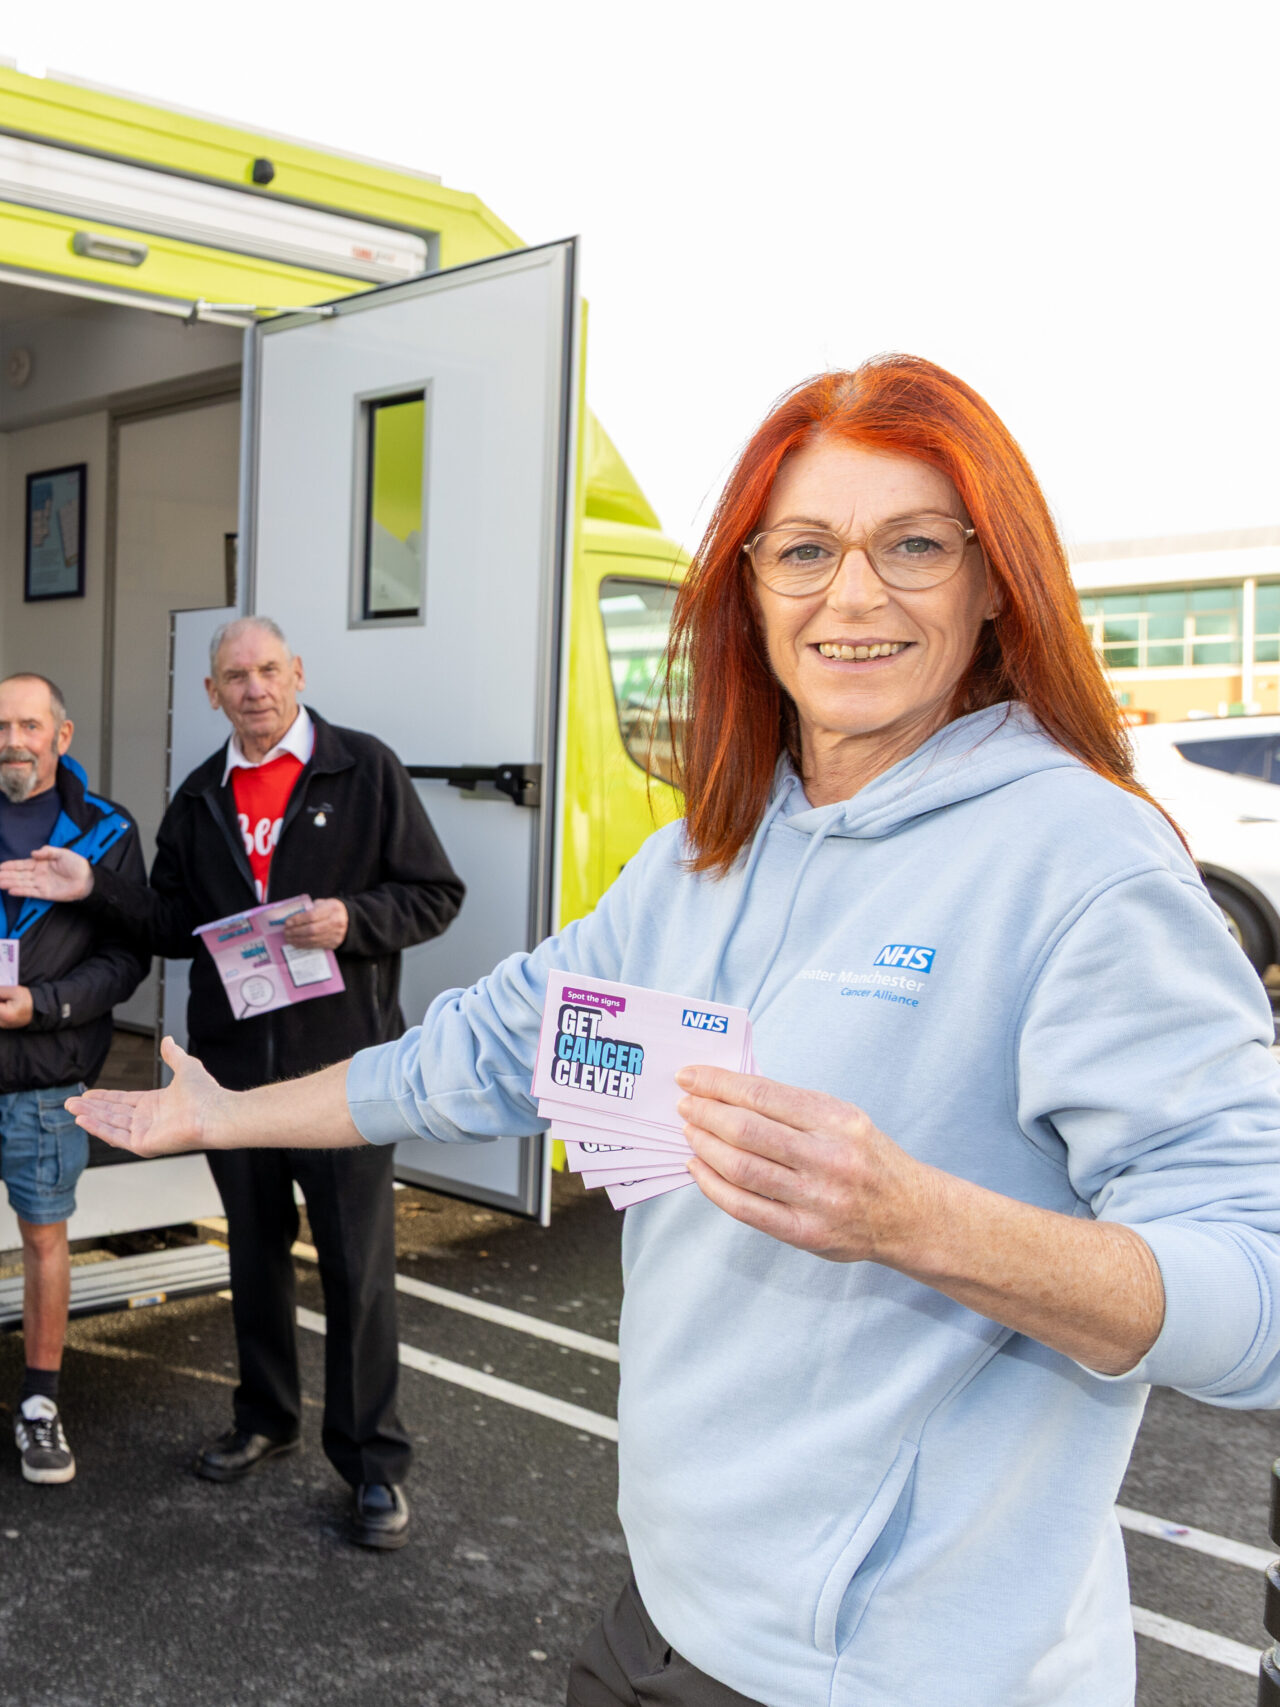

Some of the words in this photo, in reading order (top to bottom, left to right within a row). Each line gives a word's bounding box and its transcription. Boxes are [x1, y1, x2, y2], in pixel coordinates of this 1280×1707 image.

[875, 946, 933, 970] NHS
[837, 971, 925, 991] Manchester
[567, 990, 585, 1000] Spot
[587, 994, 600, 1003] the
[601, 998, 621, 1008] signs
[840, 987, 871, 997] Cancer
[872, 989, 919, 1008] Alliance
[561, 1008, 602, 1039] GET
[683, 1010, 727, 1033] NHS
[558, 1034, 645, 1075] CANCER
[555, 1060, 635, 1100] CLEVER
